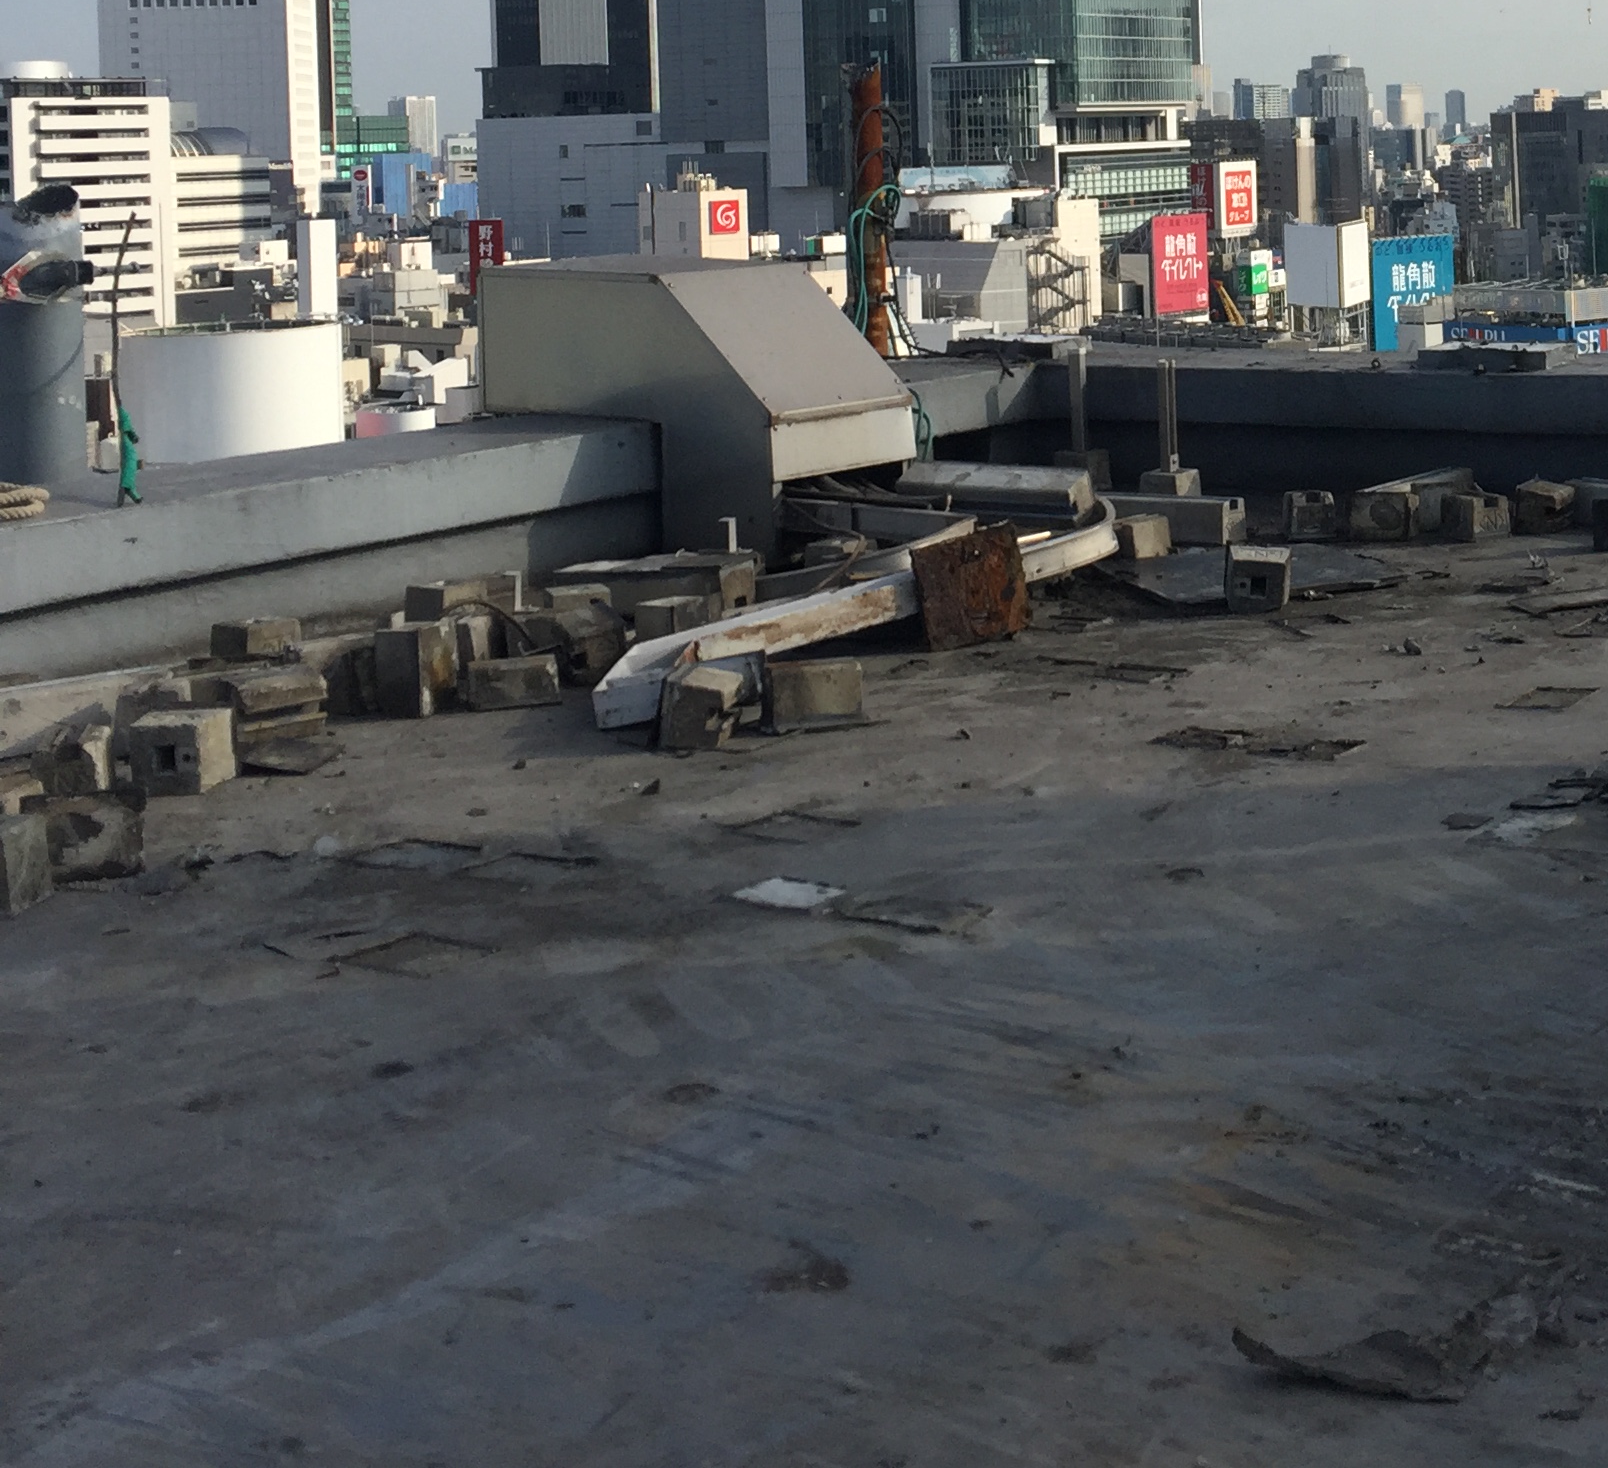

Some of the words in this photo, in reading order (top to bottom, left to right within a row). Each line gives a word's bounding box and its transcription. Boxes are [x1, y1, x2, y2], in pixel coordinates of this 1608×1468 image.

[478, 224, 493, 257] 野村
[1392, 260, 1436, 292] 龍角散
